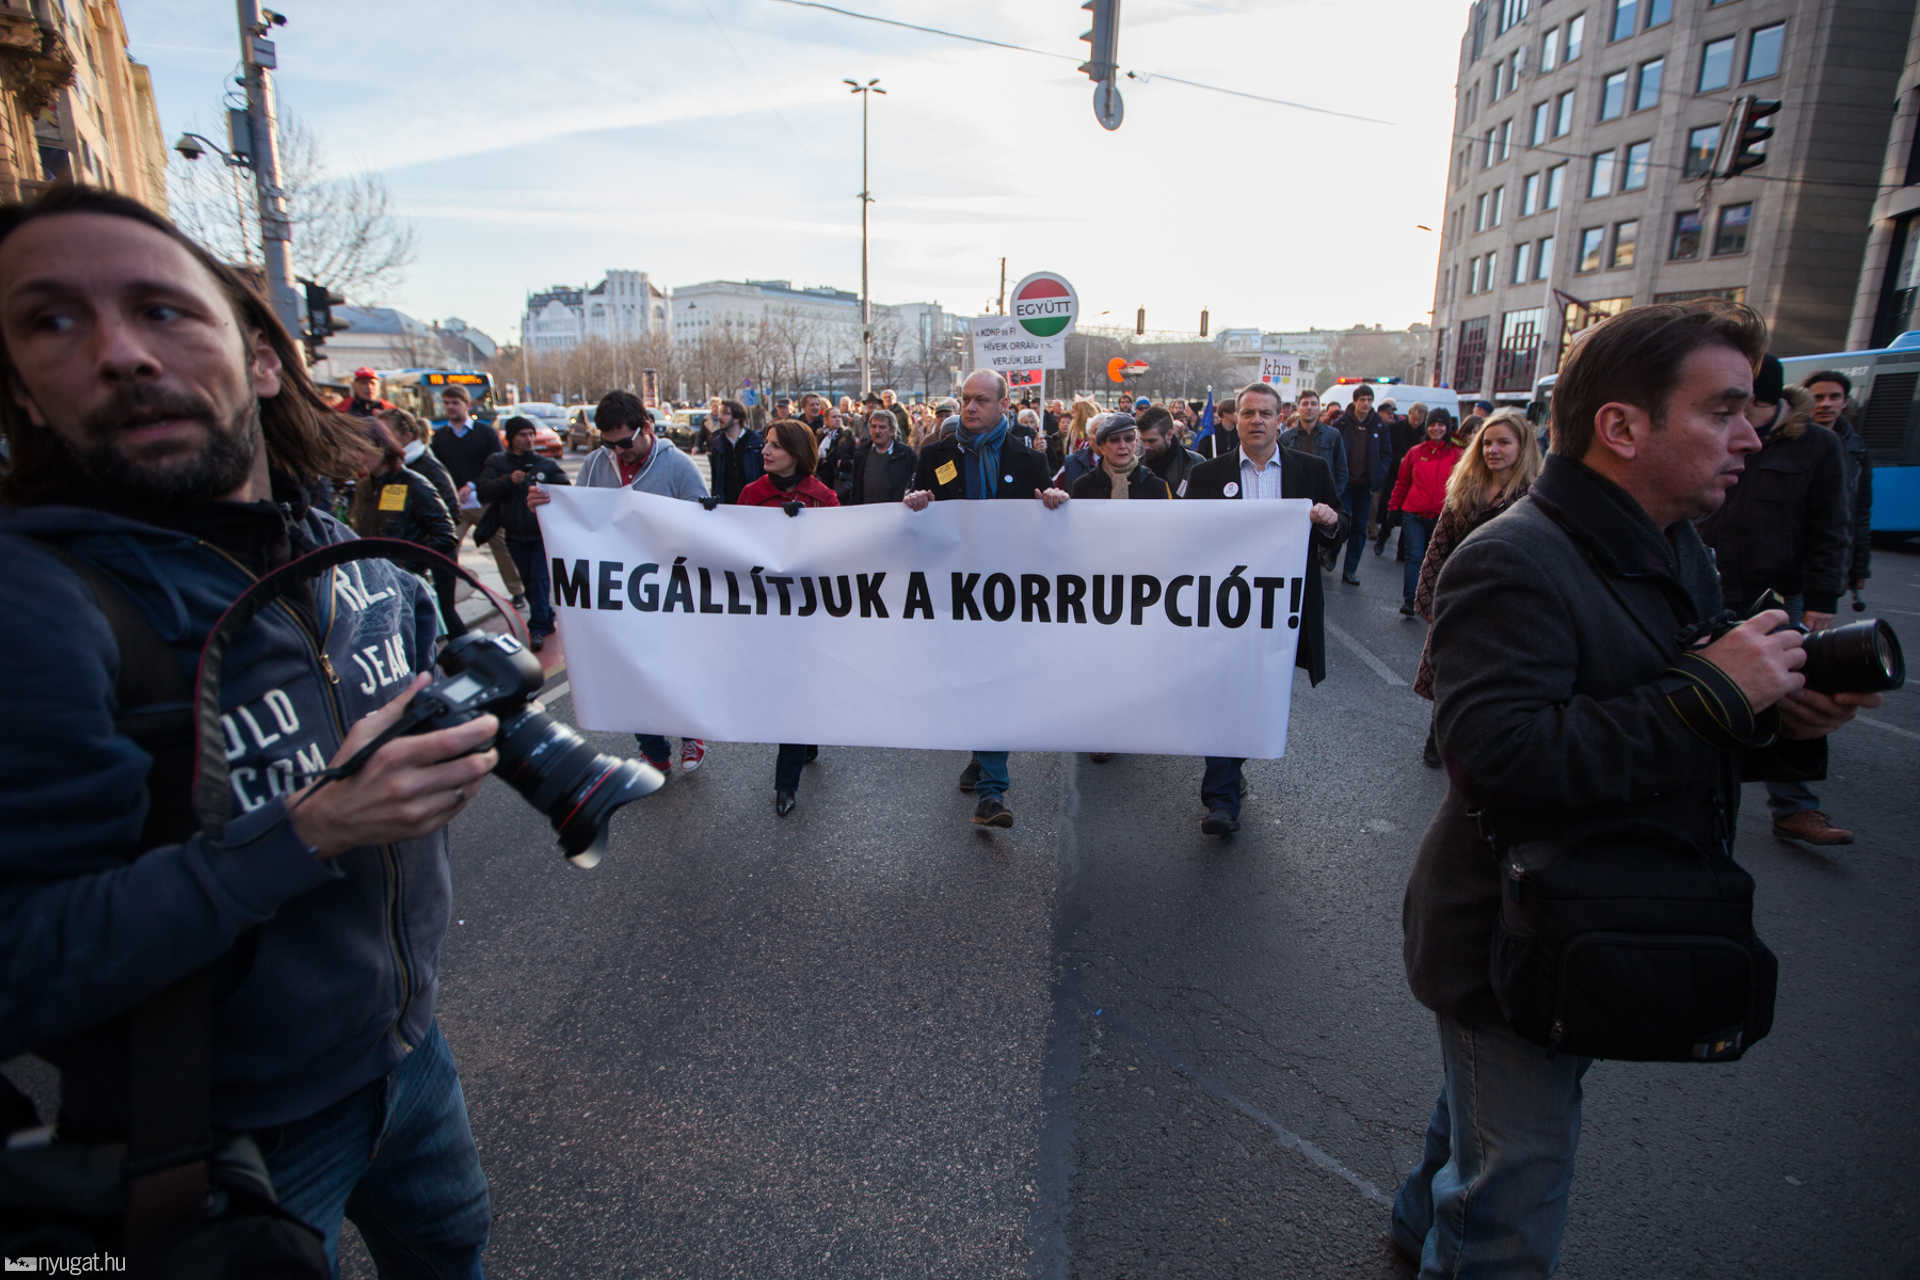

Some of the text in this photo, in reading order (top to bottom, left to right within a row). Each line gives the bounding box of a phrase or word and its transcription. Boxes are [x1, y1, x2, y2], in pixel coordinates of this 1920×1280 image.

[1016, 300, 1072, 316] EGYÜTT
[1263, 358, 1291, 376] khm
[551, 556, 1303, 630] MEGÁLLÍTJUK A KORRUPCIÓT!
